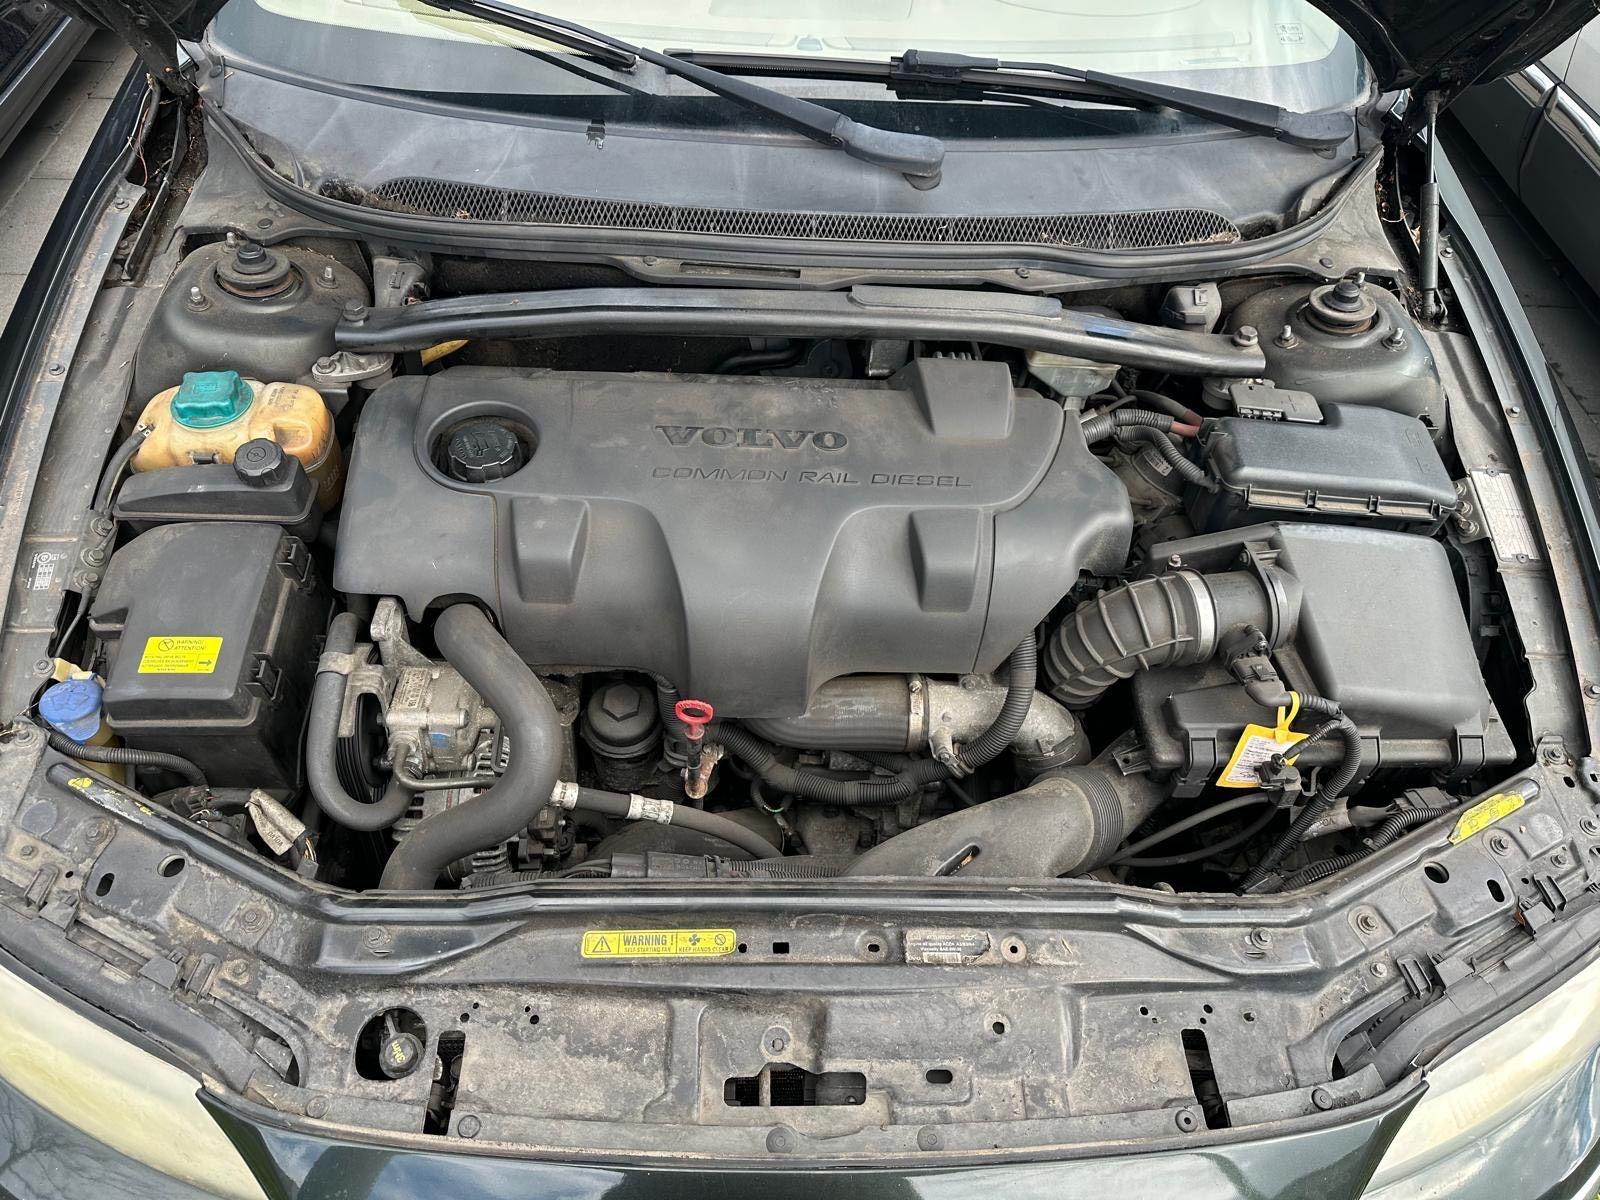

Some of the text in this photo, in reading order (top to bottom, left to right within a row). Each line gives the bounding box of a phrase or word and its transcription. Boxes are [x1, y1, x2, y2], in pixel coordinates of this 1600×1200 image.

[655, 426, 848, 451] VOLVO
[652, 467, 973, 488] COMMON RAIL DIESEL
[623, 934, 668, 946] WARNING
